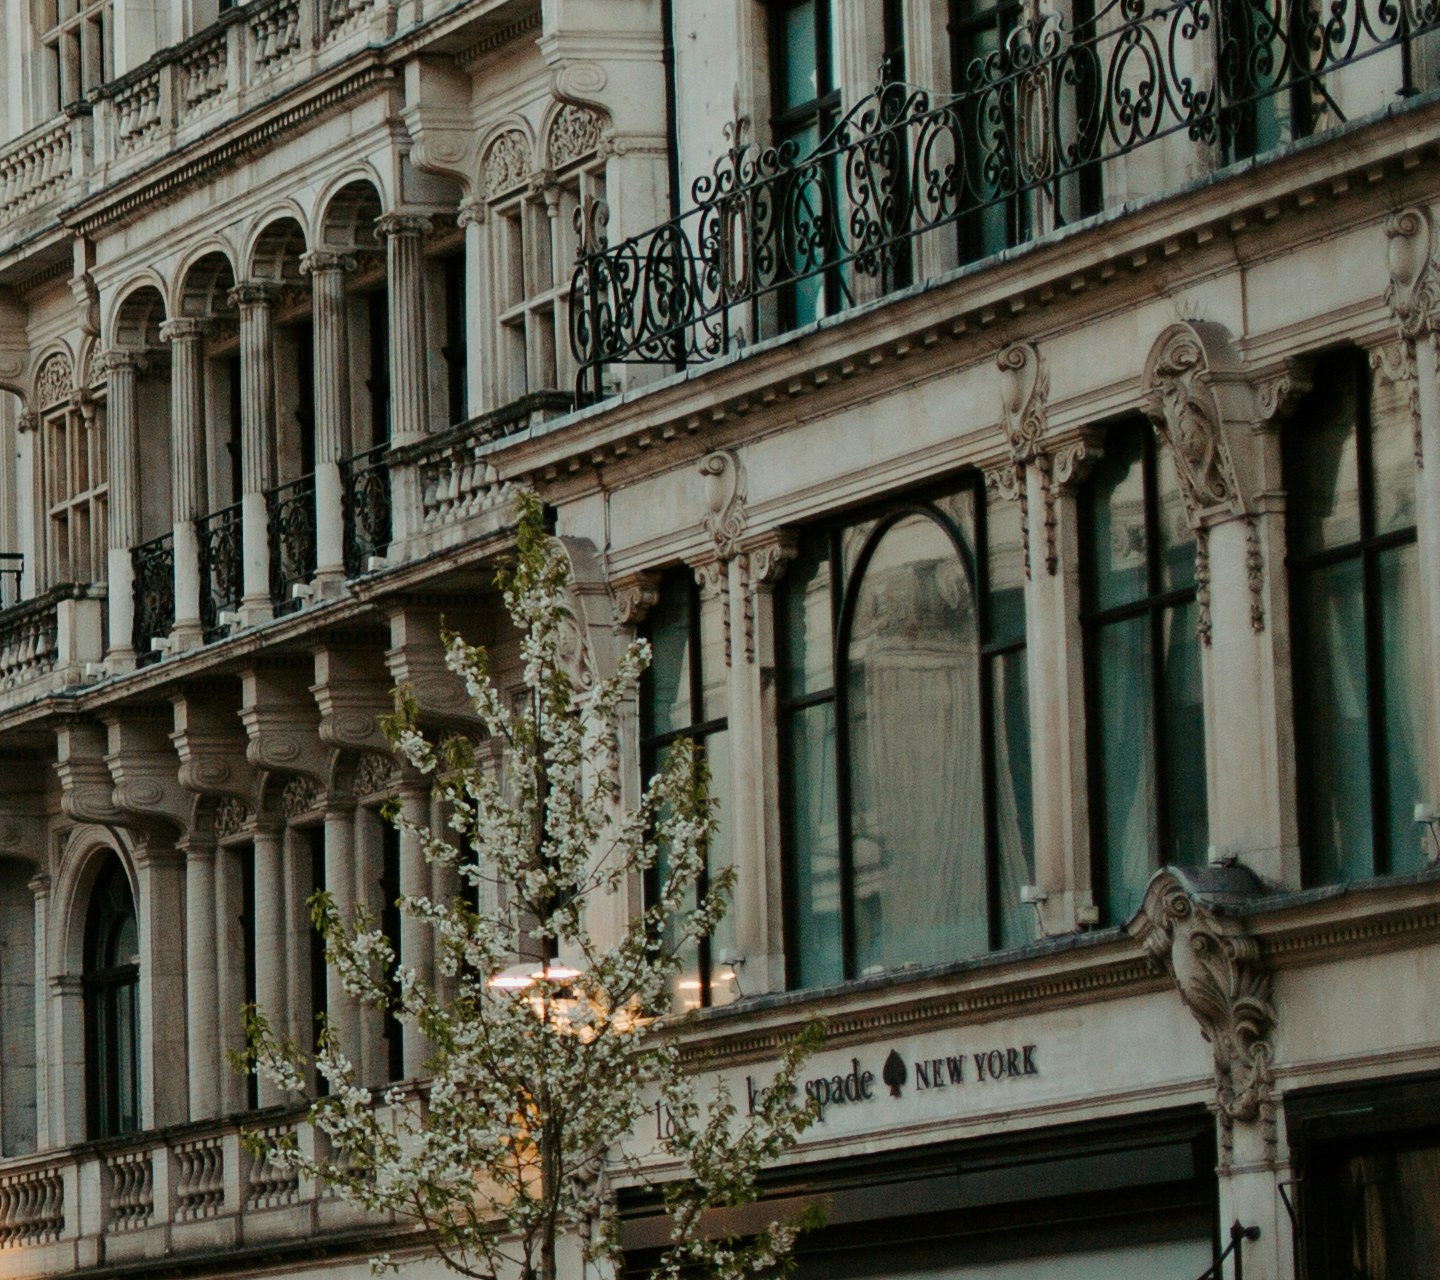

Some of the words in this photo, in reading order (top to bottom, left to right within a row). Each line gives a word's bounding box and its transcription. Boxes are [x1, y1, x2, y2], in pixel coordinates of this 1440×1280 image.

[805, 1057, 873, 1123] spade
[914, 1054, 964, 1091] NEW
[973, 1044, 1038, 1082] YORK
